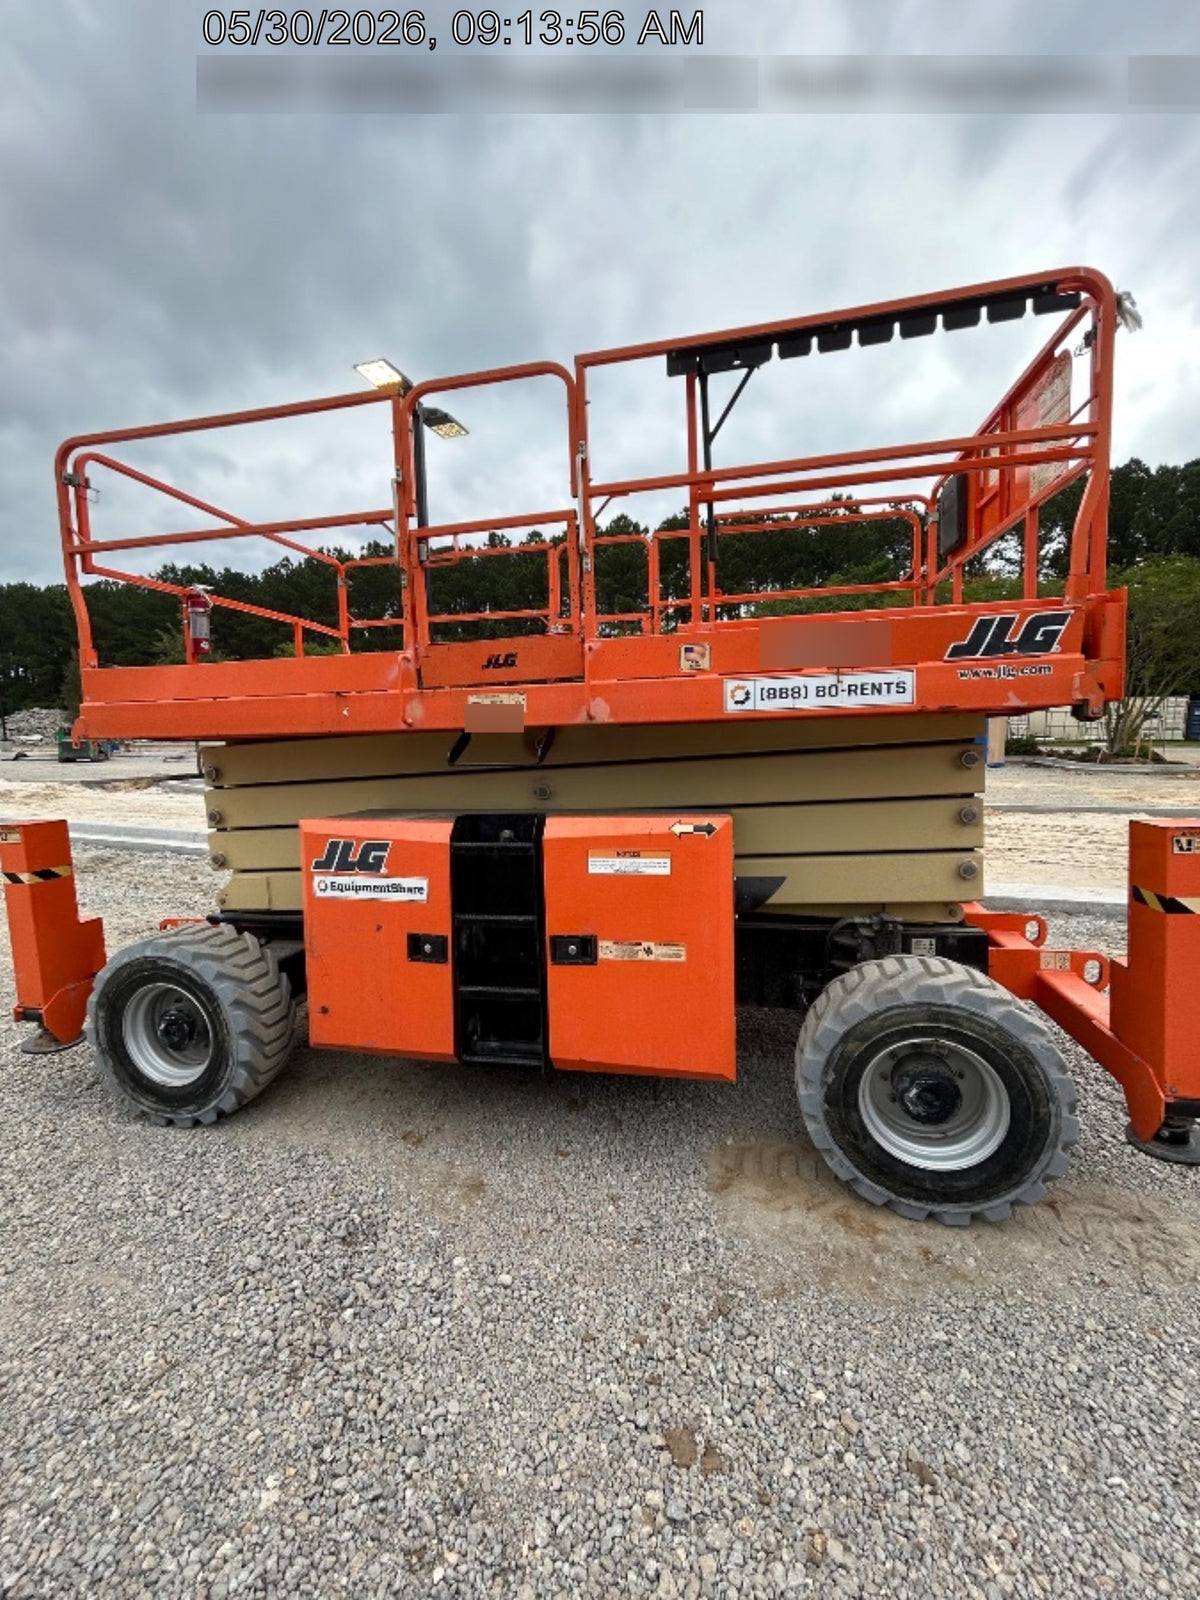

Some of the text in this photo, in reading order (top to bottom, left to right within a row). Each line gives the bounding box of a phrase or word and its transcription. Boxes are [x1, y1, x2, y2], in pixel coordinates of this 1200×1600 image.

[945, 610, 1073, 660] JLG
[481, 652, 518, 670] JLG
[957, 665, 1053, 680] www.jlg.com
[759, 684, 809, 702] (888)
[311, 839, 392, 873] JLG
[329, 881, 425, 896] EquipmentShare
